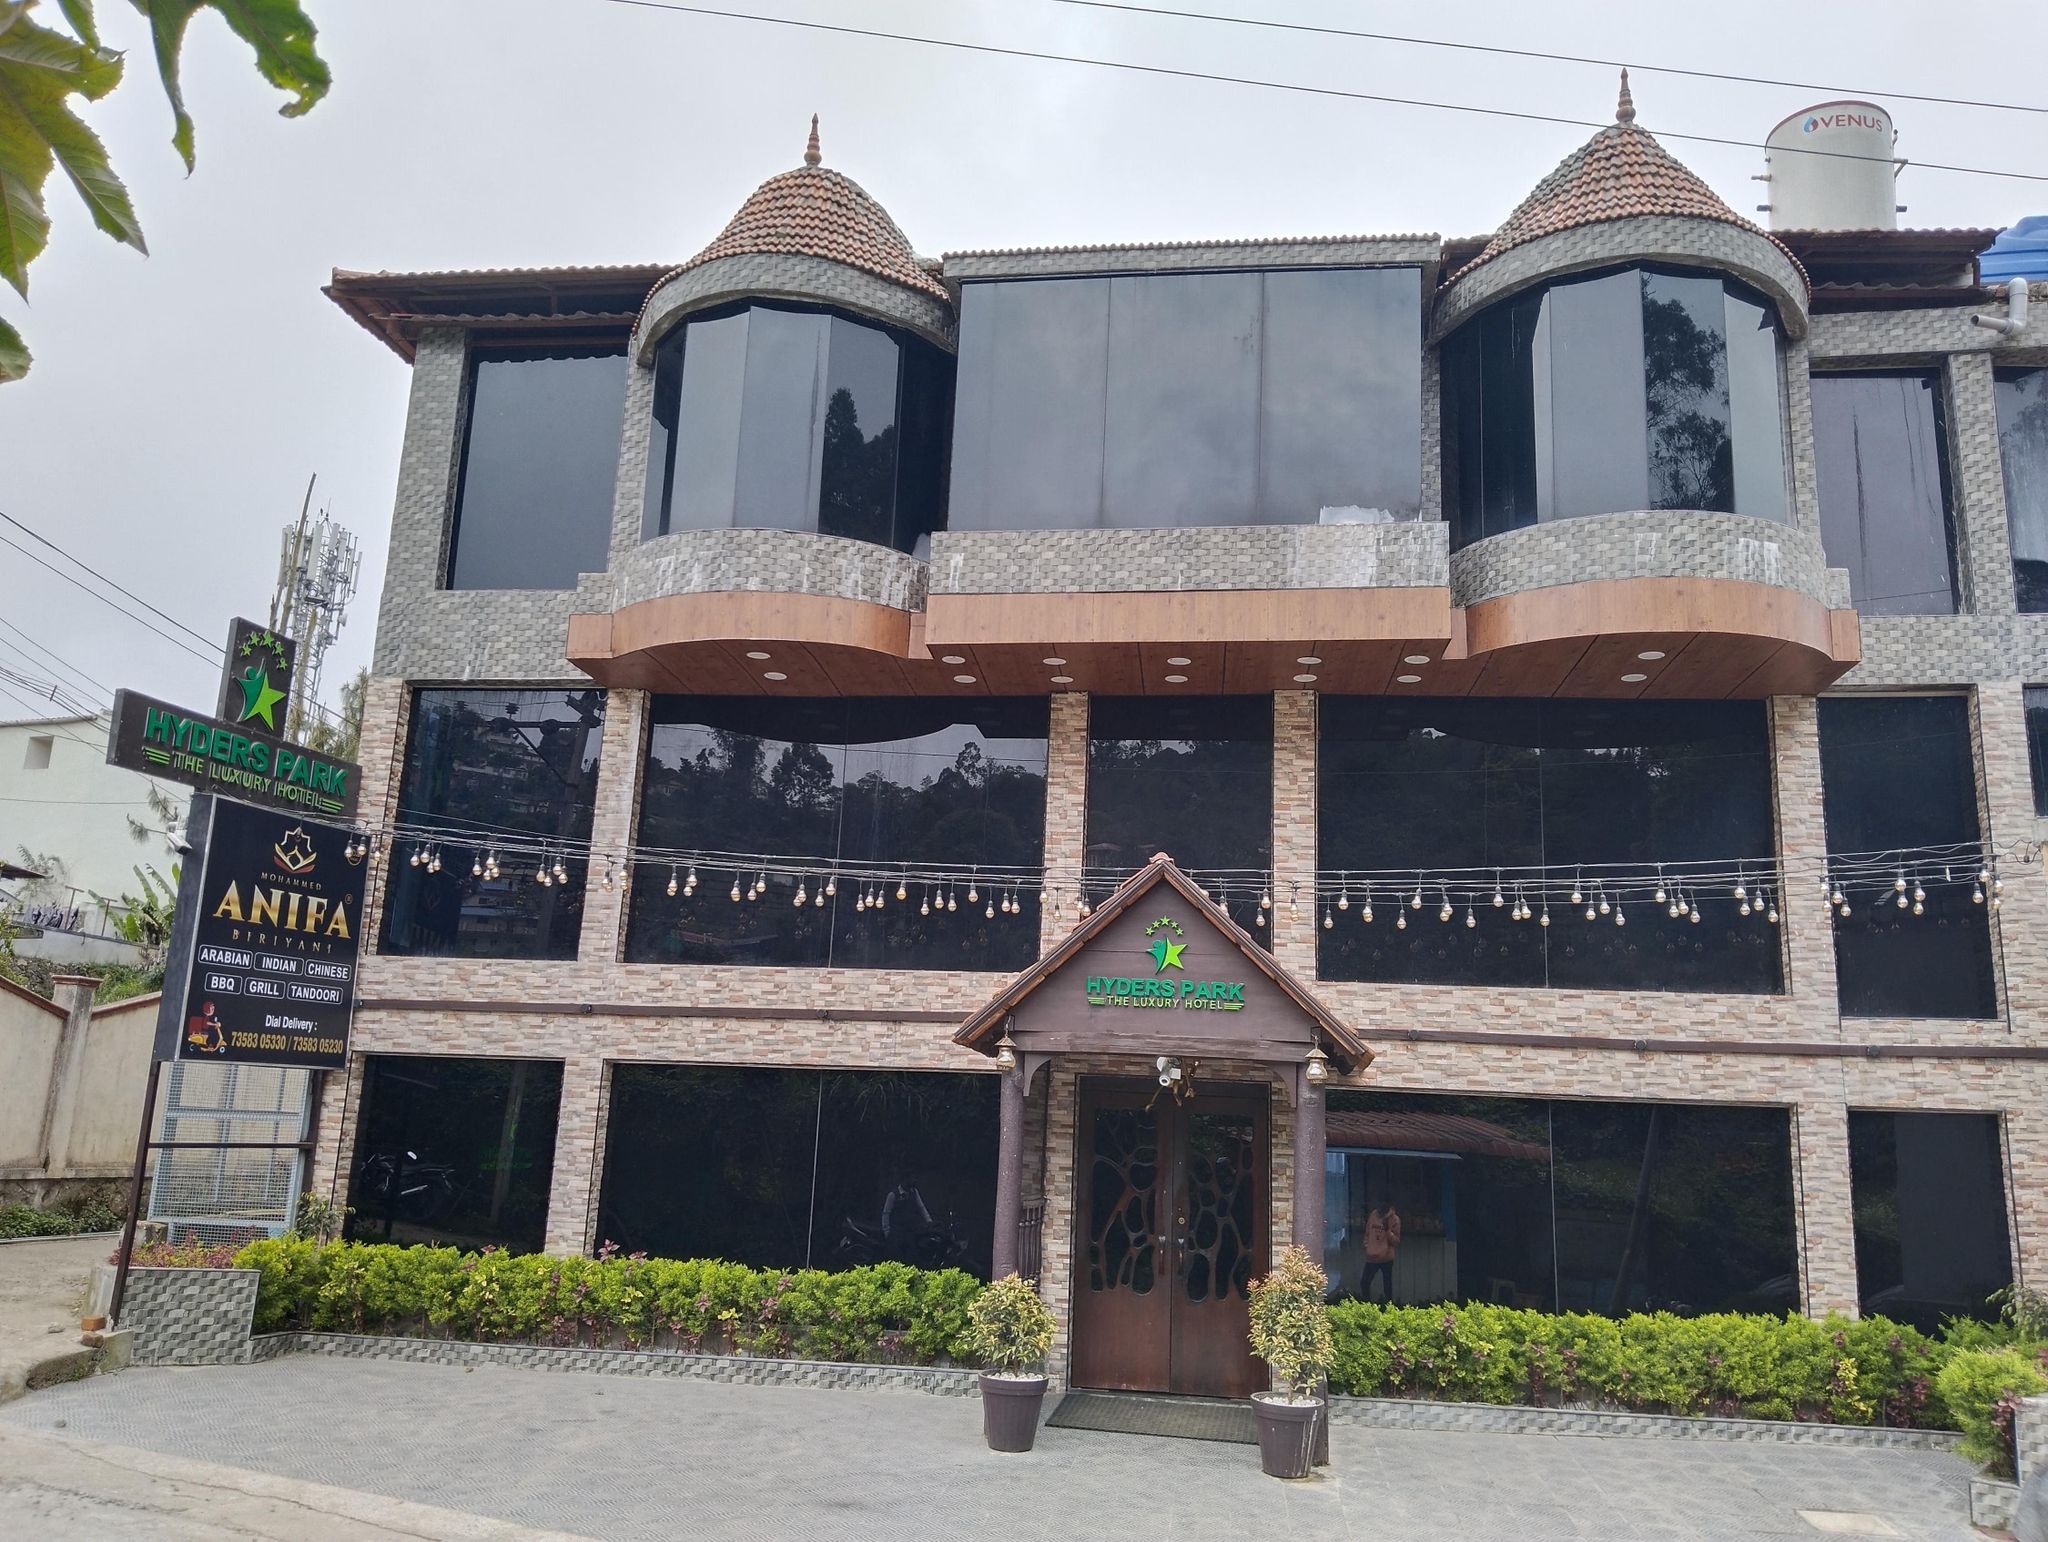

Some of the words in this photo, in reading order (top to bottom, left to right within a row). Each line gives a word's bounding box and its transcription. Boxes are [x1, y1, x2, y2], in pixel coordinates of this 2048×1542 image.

[1820, 114, 1883, 132] VENUS
[144, 707, 271, 772] HYDERS
[273, 748, 350, 797] PARK
[174, 751, 204, 774] THE
[209, 762, 272, 793] LUXURY
[274, 781, 323, 808] HOTEL
[261, 872, 322, 891] MOHAMMED
[212, 879, 352, 939] ANIFA
[232, 929, 332, 954] BIRIYANI
[200, 948, 251, 966] ARABIAN
[262, 956, 297, 972] INDIAN
[307, 963, 349, 979] CHINESE
[210, 976, 235, 991] BBQ
[249, 980, 280, 996] GRILL
[291, 985, 340, 1002] TANDOORI
[1086, 976, 1176, 998] HYDERS
[1180, 979, 1246, 1001] PARK
[1106, 995, 1130, 1007] THE
[1133, 997, 1181, 1009] LUXURY
[1185, 999, 1224, 1010] HOTEL
[265, 1014, 282, 1028] Dial
[231, 1031, 258, 1049] 73583
[260, 1033, 287, 1051] 05330
[293, 1036, 318, 1053] 73583
[319, 1038, 344, 1054] 05230
